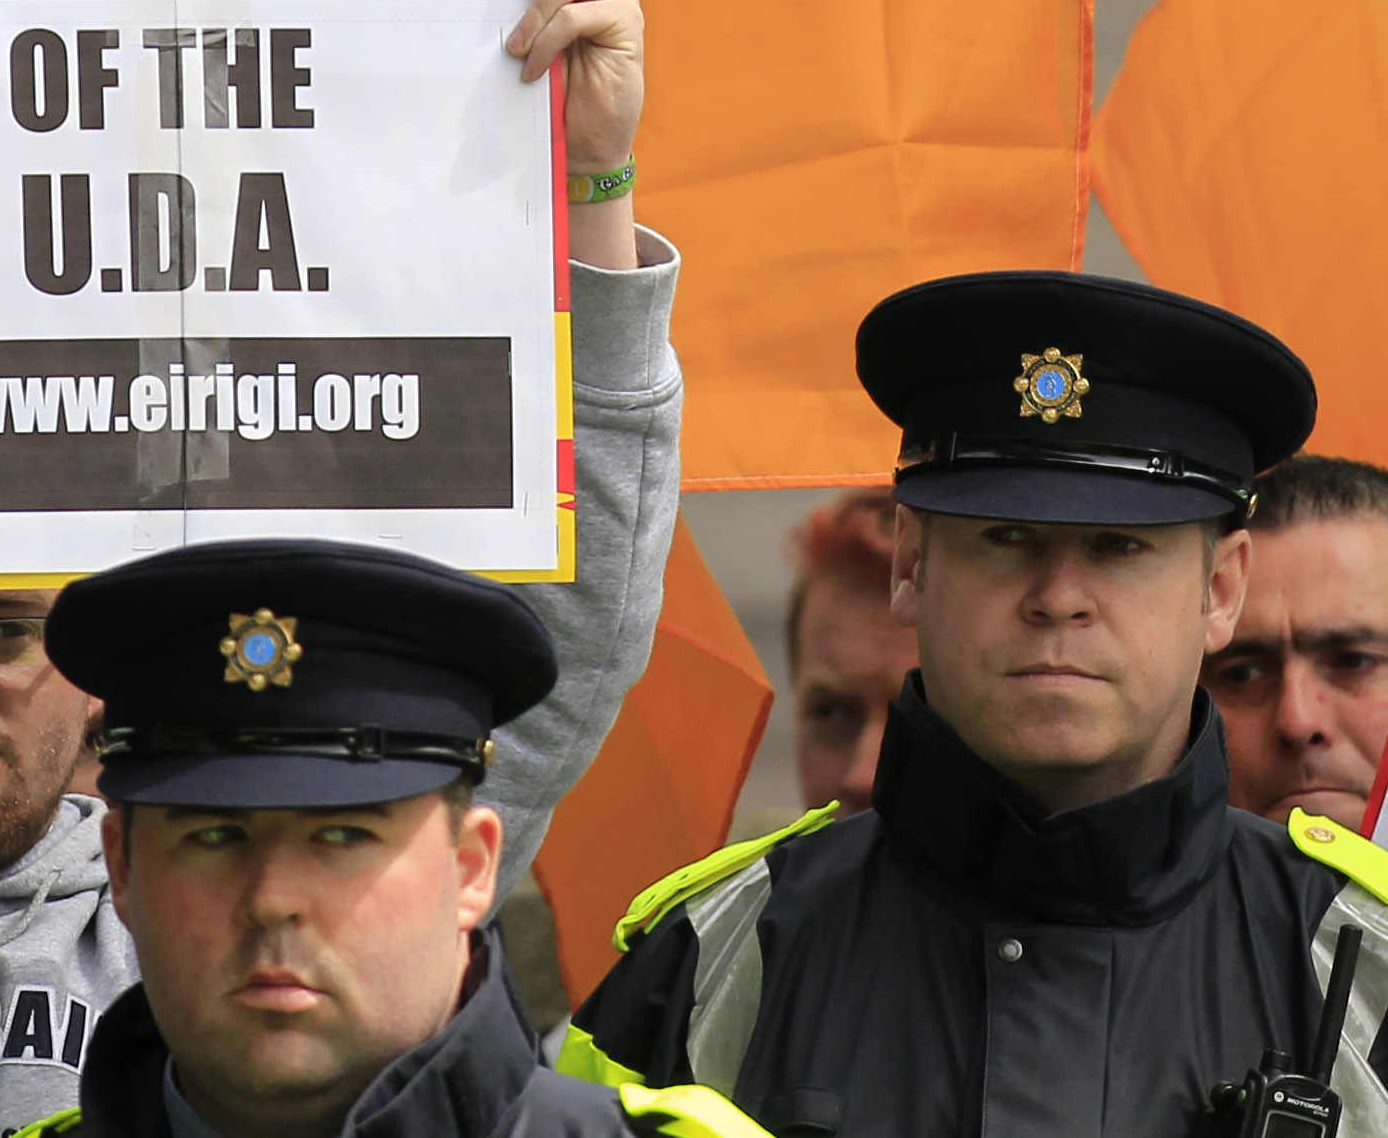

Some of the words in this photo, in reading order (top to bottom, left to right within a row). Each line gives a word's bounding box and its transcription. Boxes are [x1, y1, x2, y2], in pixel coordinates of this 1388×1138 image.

[10, 27, 119, 133] OF
[142, 27, 316, 130] THE
[21, 172, 330, 296] U.D.A.
